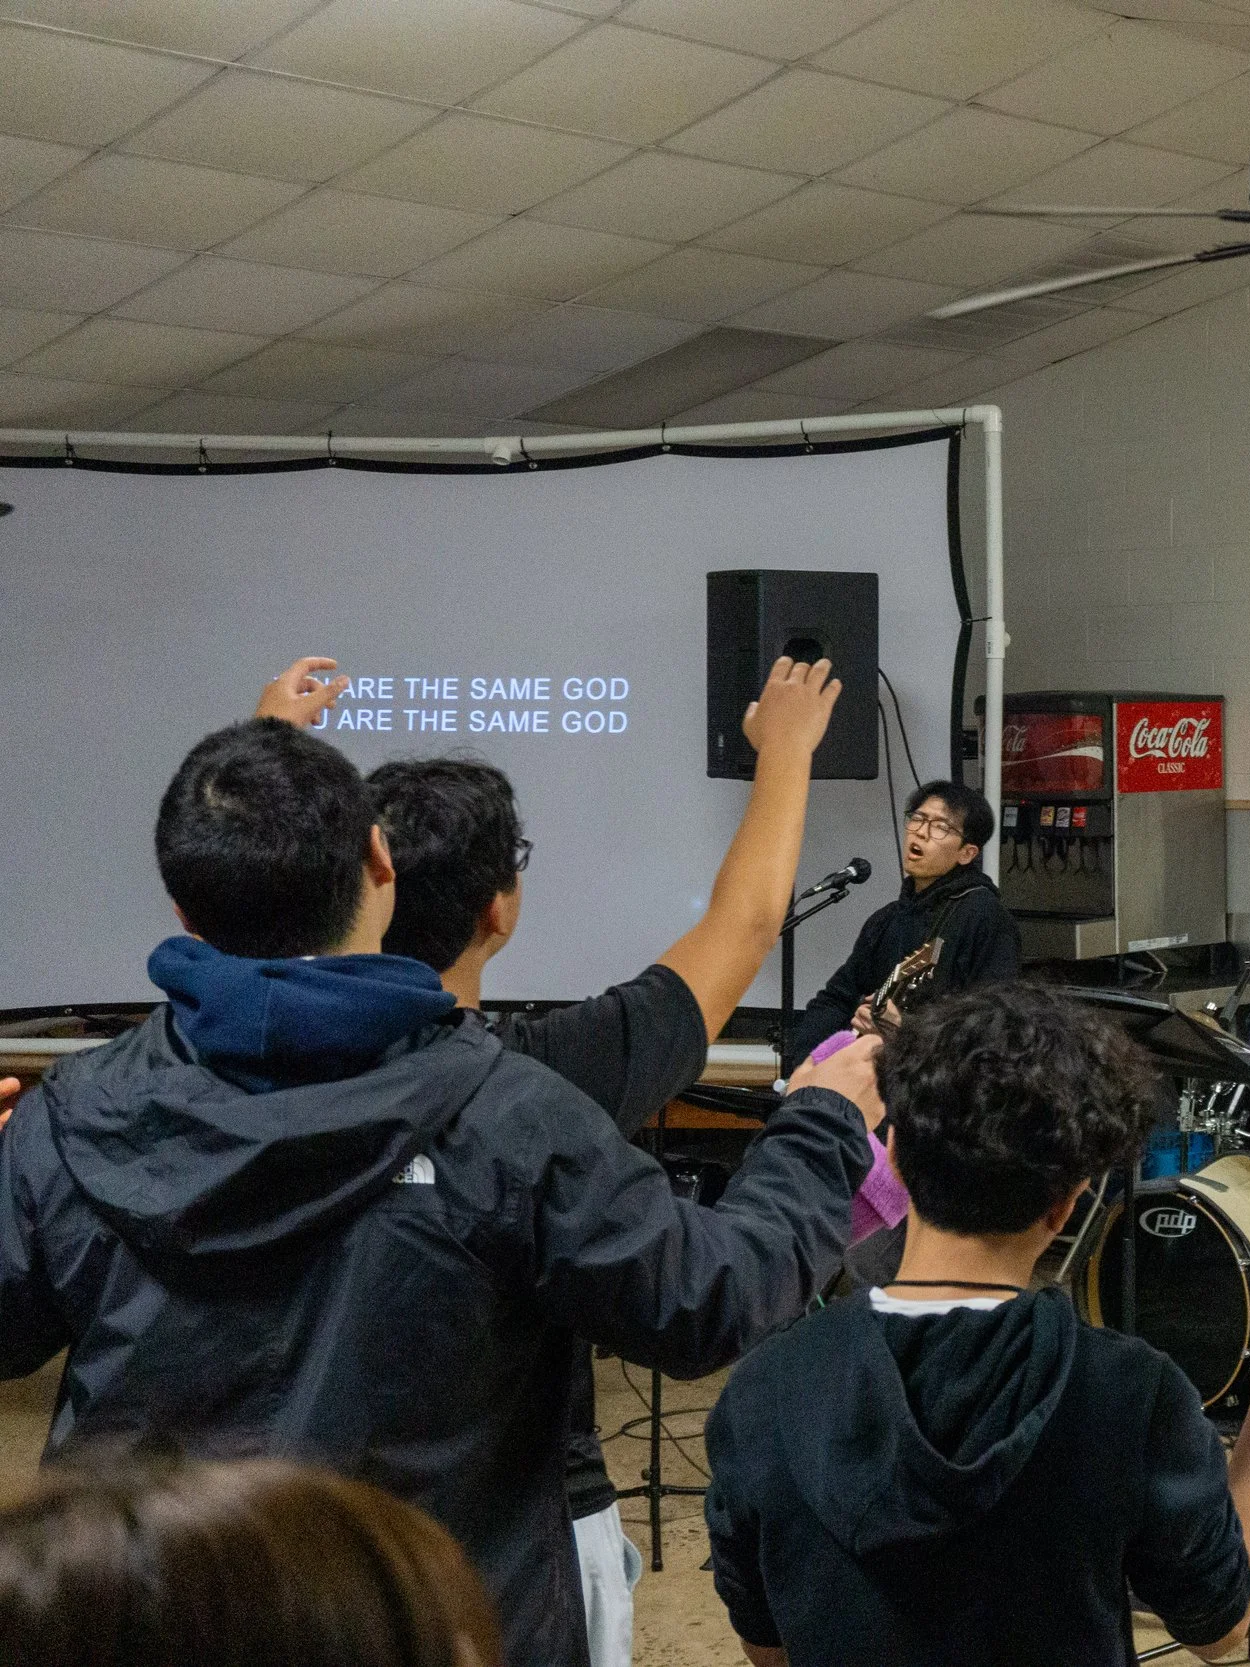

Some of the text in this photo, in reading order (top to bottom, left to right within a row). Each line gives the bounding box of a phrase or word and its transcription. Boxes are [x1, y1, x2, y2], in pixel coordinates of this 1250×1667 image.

[404, 677, 459, 699] THE
[470, 677, 551, 700] SAME
[563, 677, 629, 700] GOD
[337, 709, 393, 731] ARE
[403, 709, 458, 731] THE
[469, 710, 549, 732] SAME
[562, 710, 628, 733] GOD
[1129, 717, 1211, 759] Coca-Cola
[1157, 762, 1186, 774] CLASSIC
[1155, 1209, 1197, 1235] pdp
